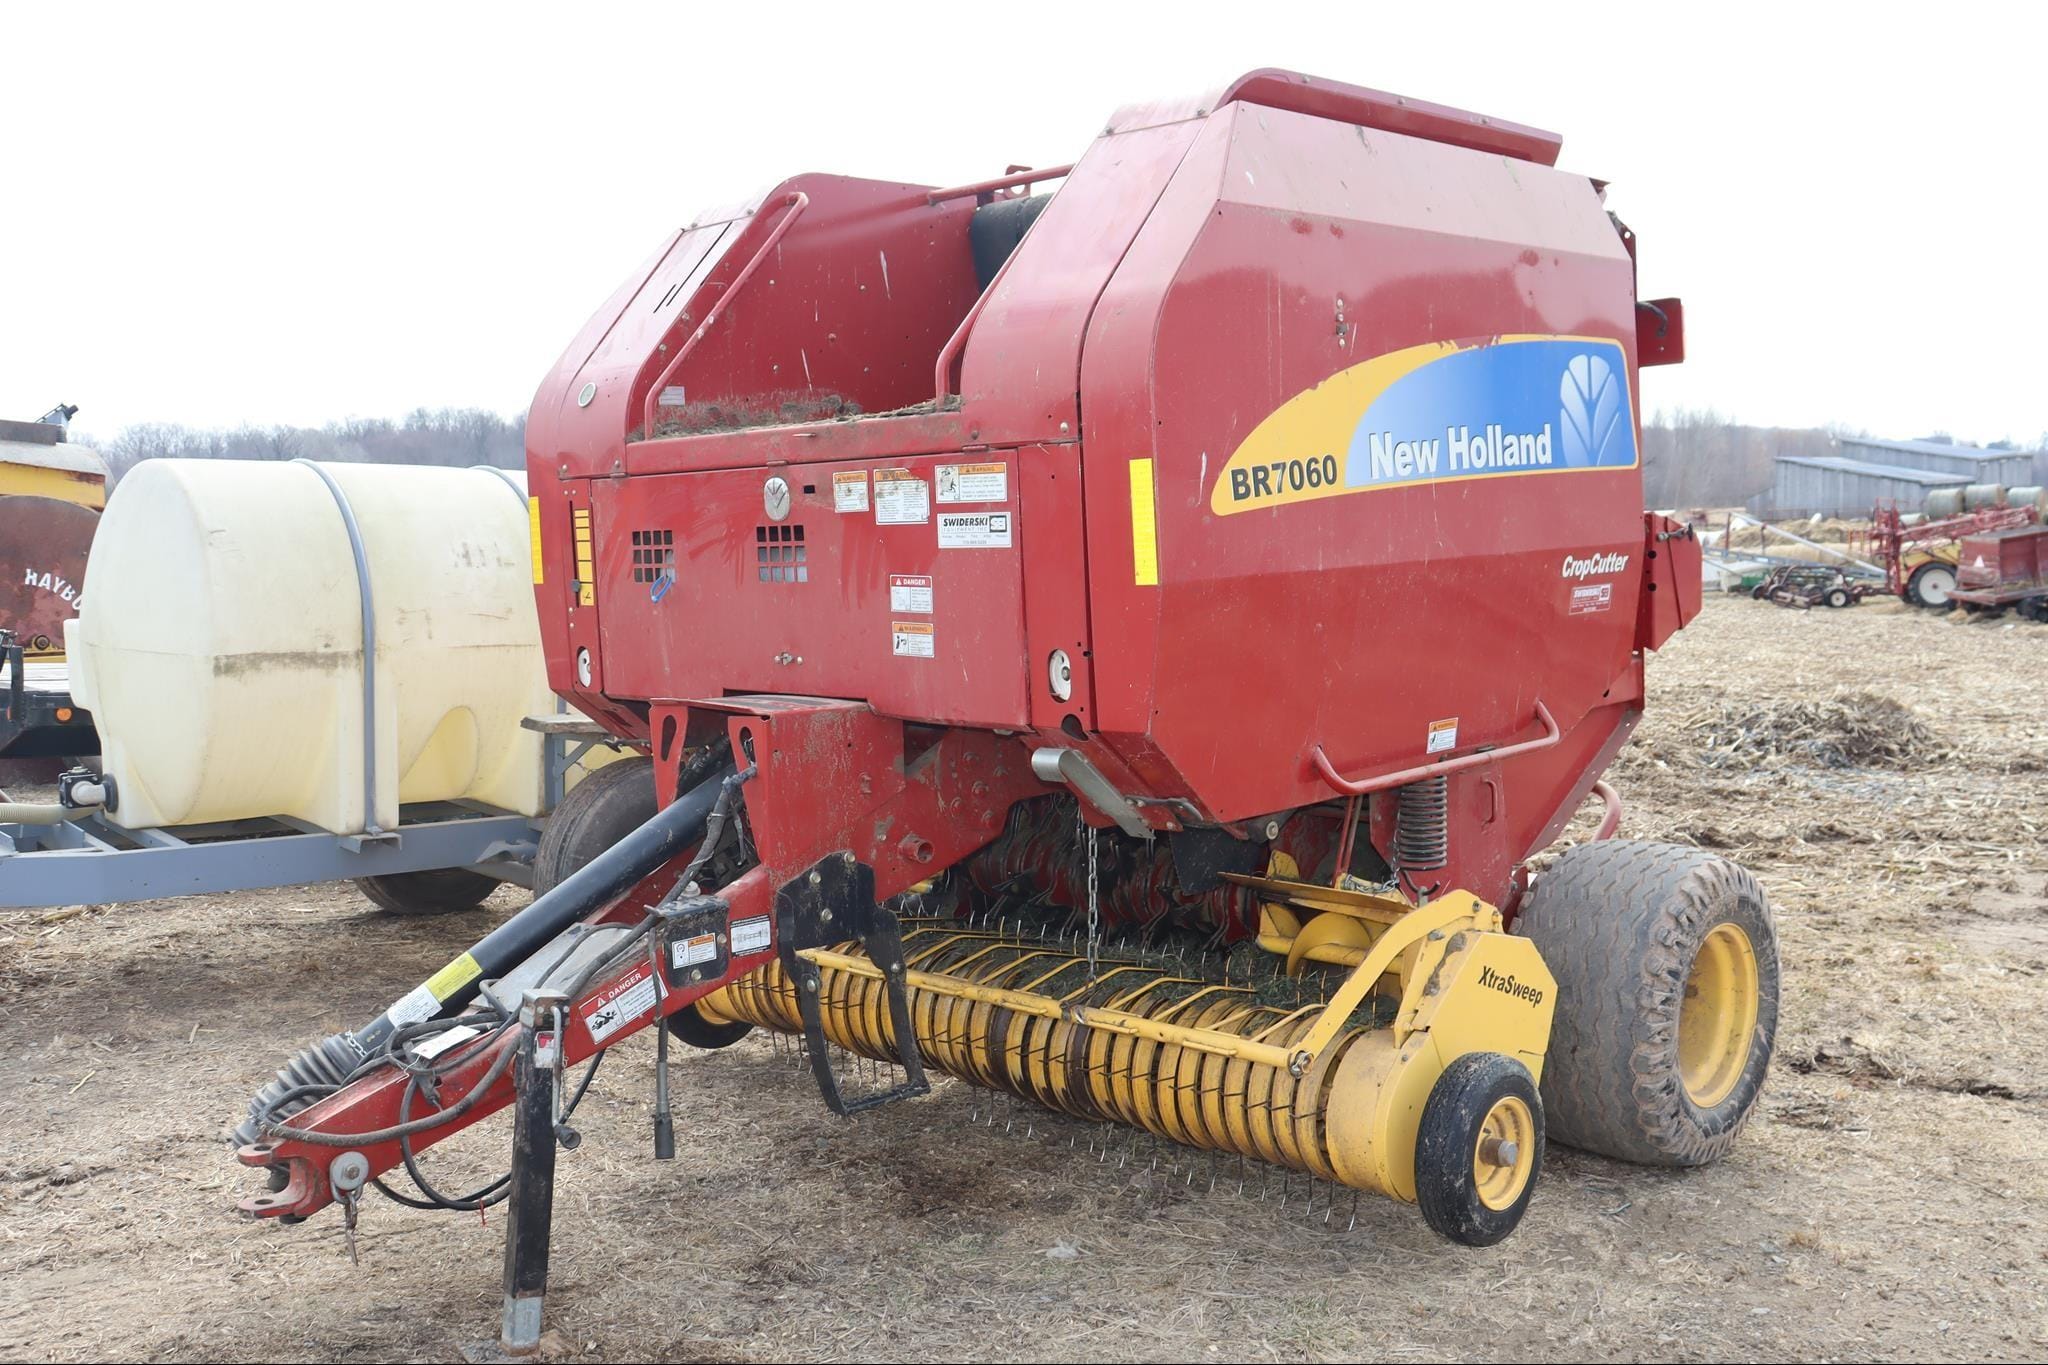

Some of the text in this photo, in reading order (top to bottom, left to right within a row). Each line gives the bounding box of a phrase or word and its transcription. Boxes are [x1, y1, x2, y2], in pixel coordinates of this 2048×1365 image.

[1368, 423, 1553, 480] New Holland
[1230, 454, 1338, 501] BR7060
[943, 518, 988, 527] SWIDERSKI
[1562, 552, 1630, 581] CropCutter
[608, 972, 642, 999] DANGER
[1478, 965, 1543, 1009] XtraSweep
